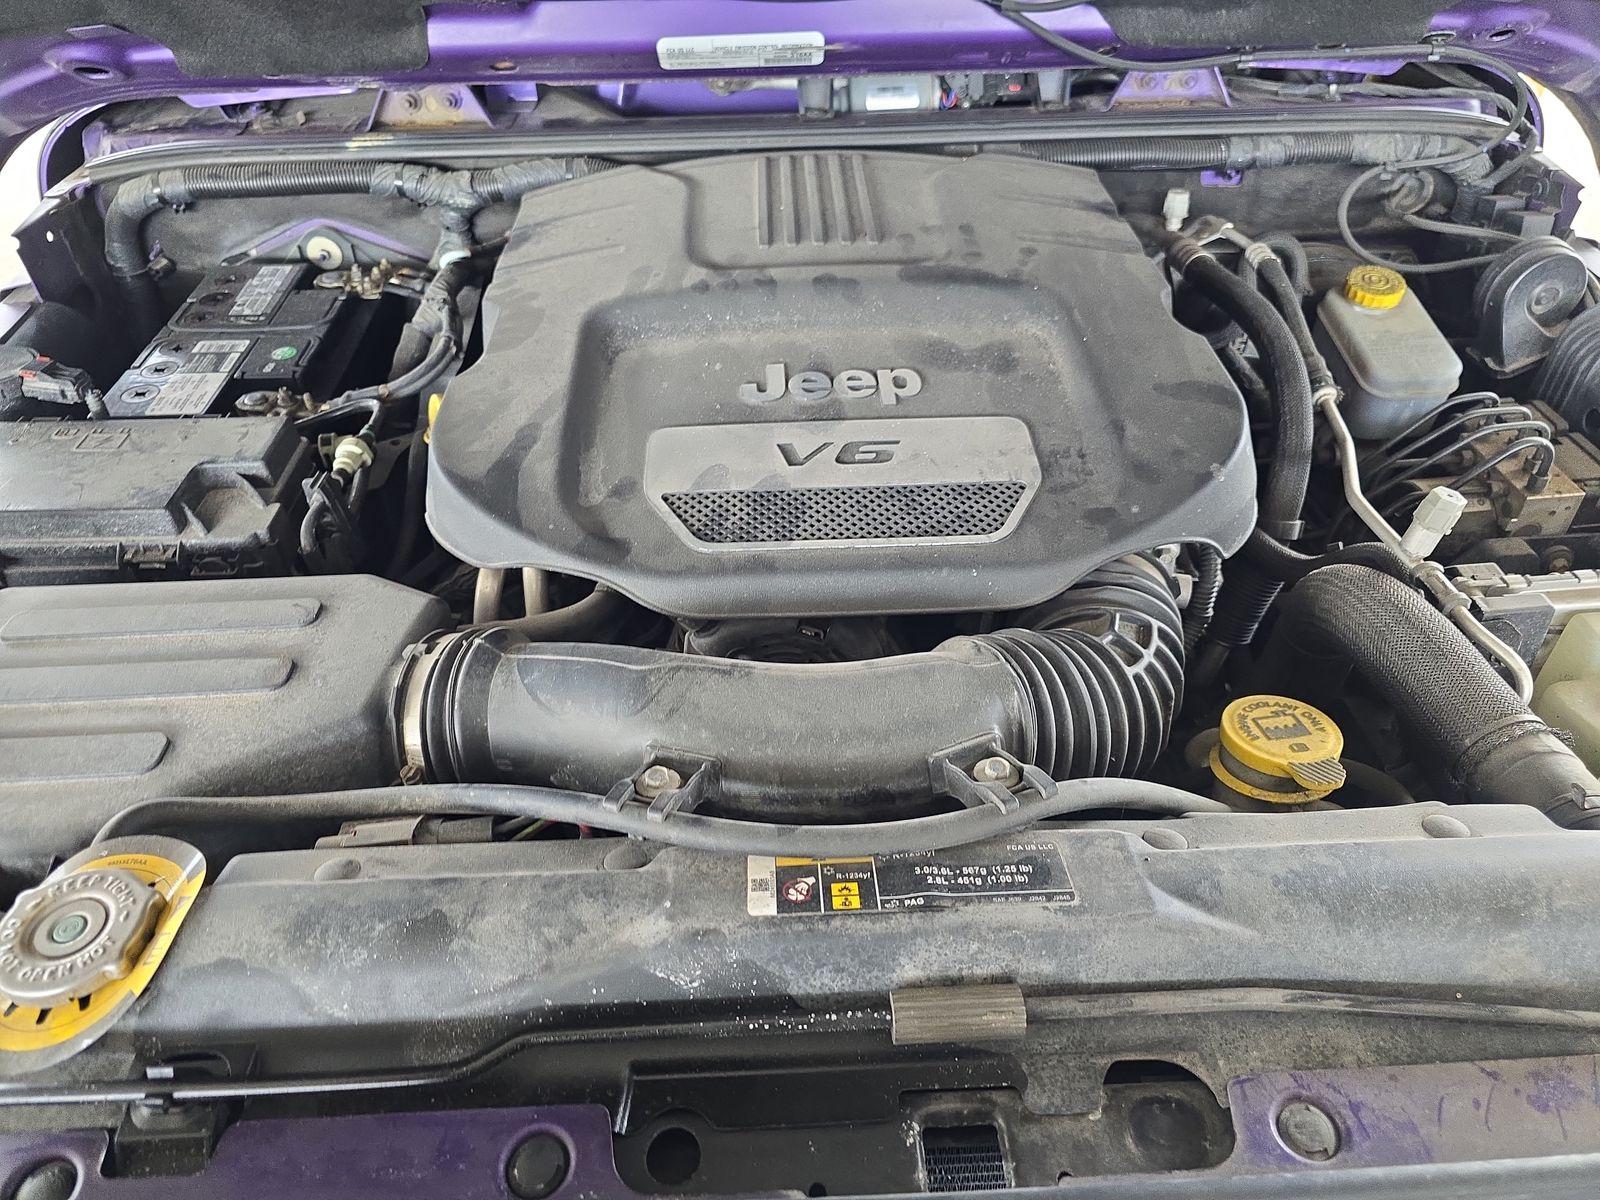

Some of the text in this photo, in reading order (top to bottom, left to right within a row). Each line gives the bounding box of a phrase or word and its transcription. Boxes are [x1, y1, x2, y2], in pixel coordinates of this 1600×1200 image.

[739, 363, 923, 406] Jeep
[776, 440, 901, 467] V6
[1242, 701, 1300, 712] COOLANT
[1301, 711, 1327, 733] ONLY
[1037, 843, 1055, 851] LLC
[836, 871, 872, 880] R-1234yf
[992, 865, 1017, 875] (1.25
[1018, 864, 1033, 874] lb)
[987, 874, 1012, 885] (1.00
[1014, 874, 1029, 884] lb)
[48, 874, 135, 907] KEEP TIGHT
[904, 898, 925, 907] PAG
[19, 962, 74, 982] OPEN
[77, 935, 115, 969] HOT
